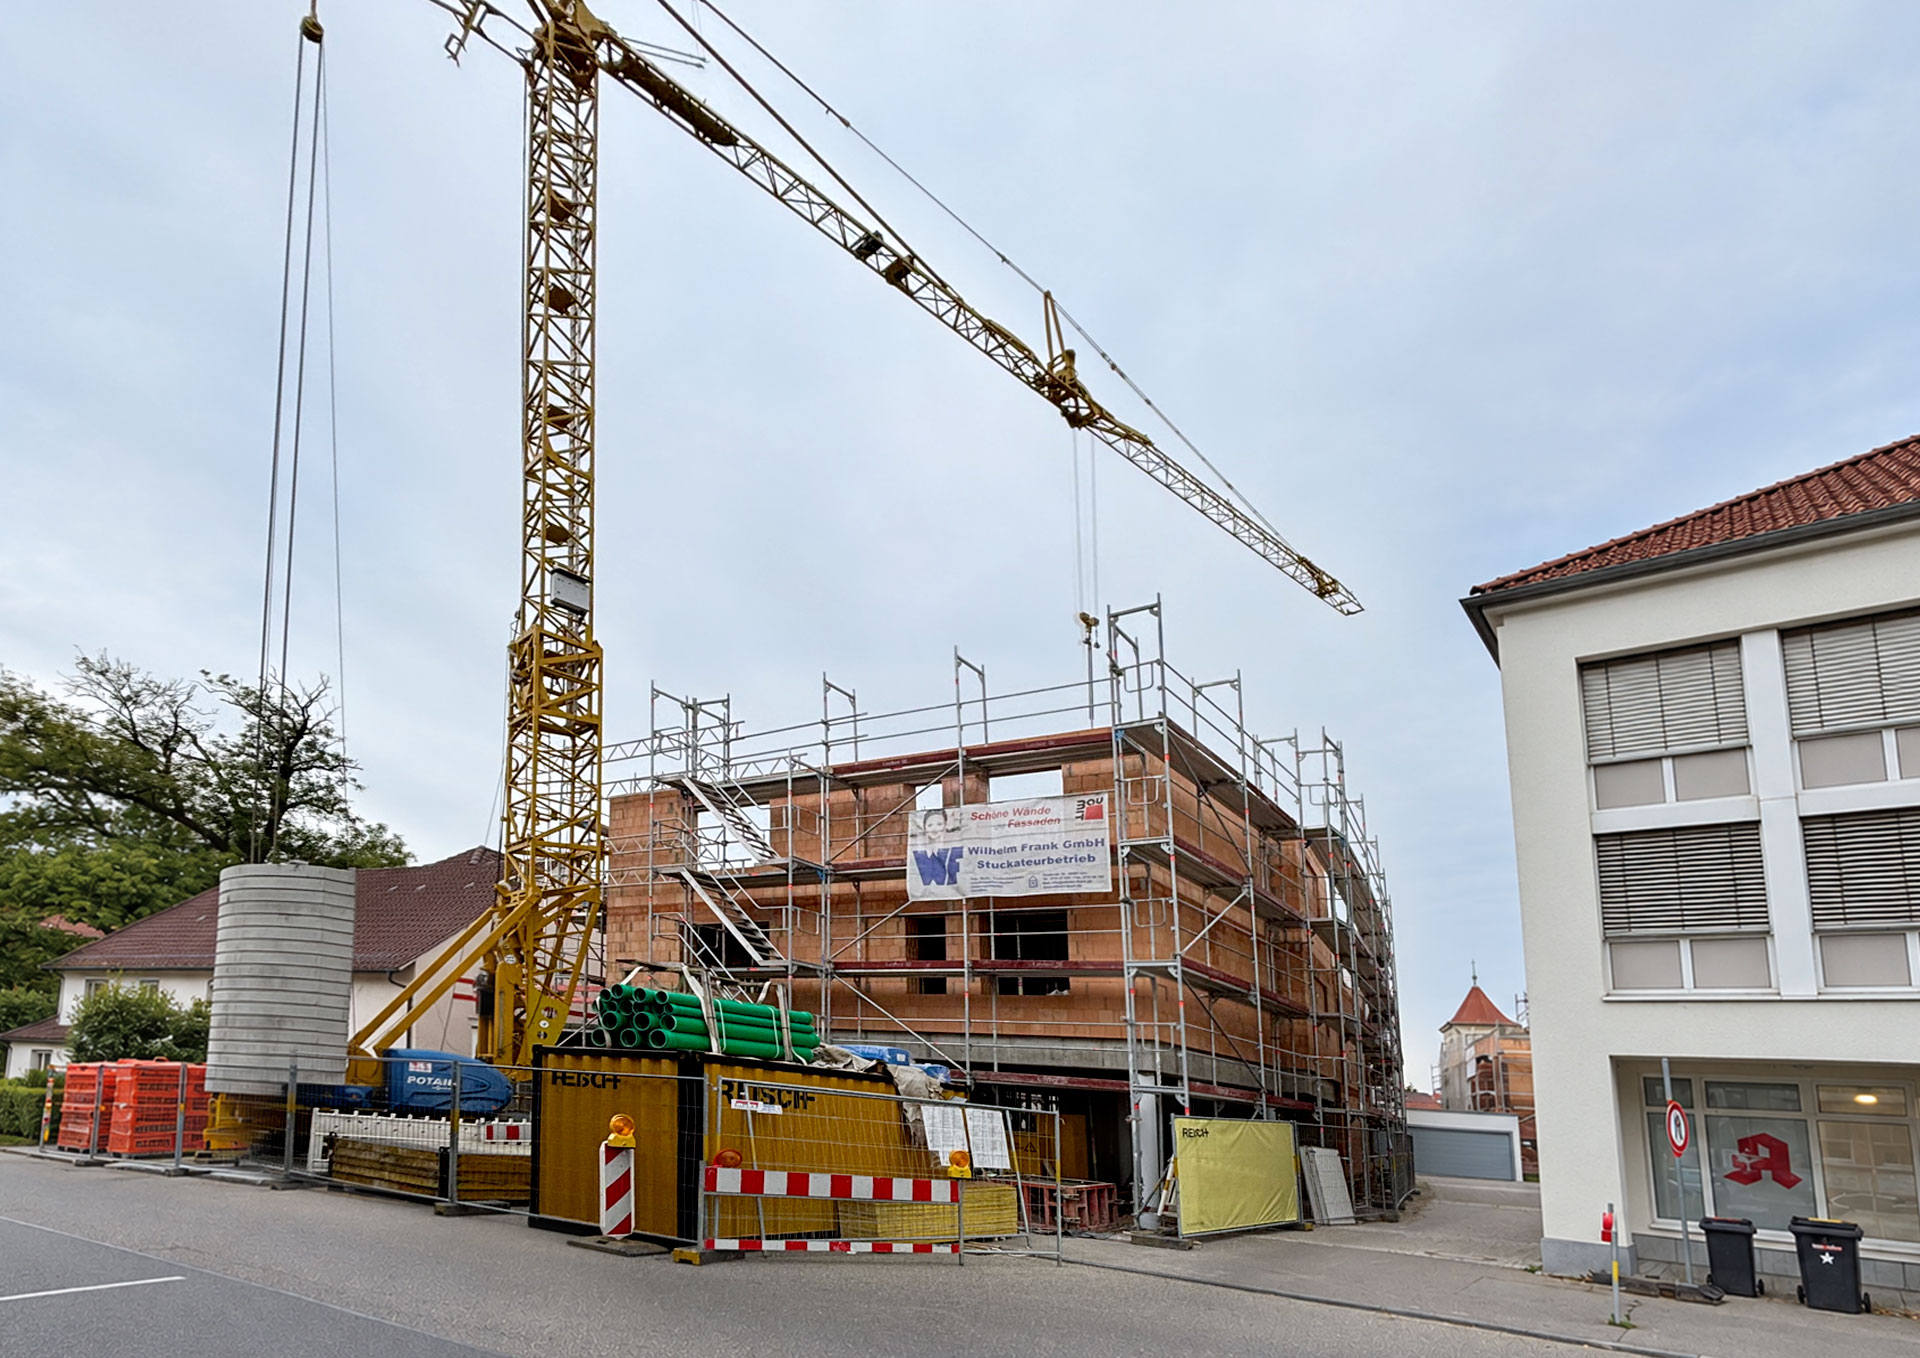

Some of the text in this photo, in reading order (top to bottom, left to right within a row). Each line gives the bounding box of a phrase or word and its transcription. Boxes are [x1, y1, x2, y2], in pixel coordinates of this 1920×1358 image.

[1012, 806, 1051, 817] Wände
[1007, 817, 1061, 828] Fassaden
[967, 837, 1105, 856] Wilhelm Frank GmbH
[977, 854, 1096, 869] Stuckateurbetrieb
